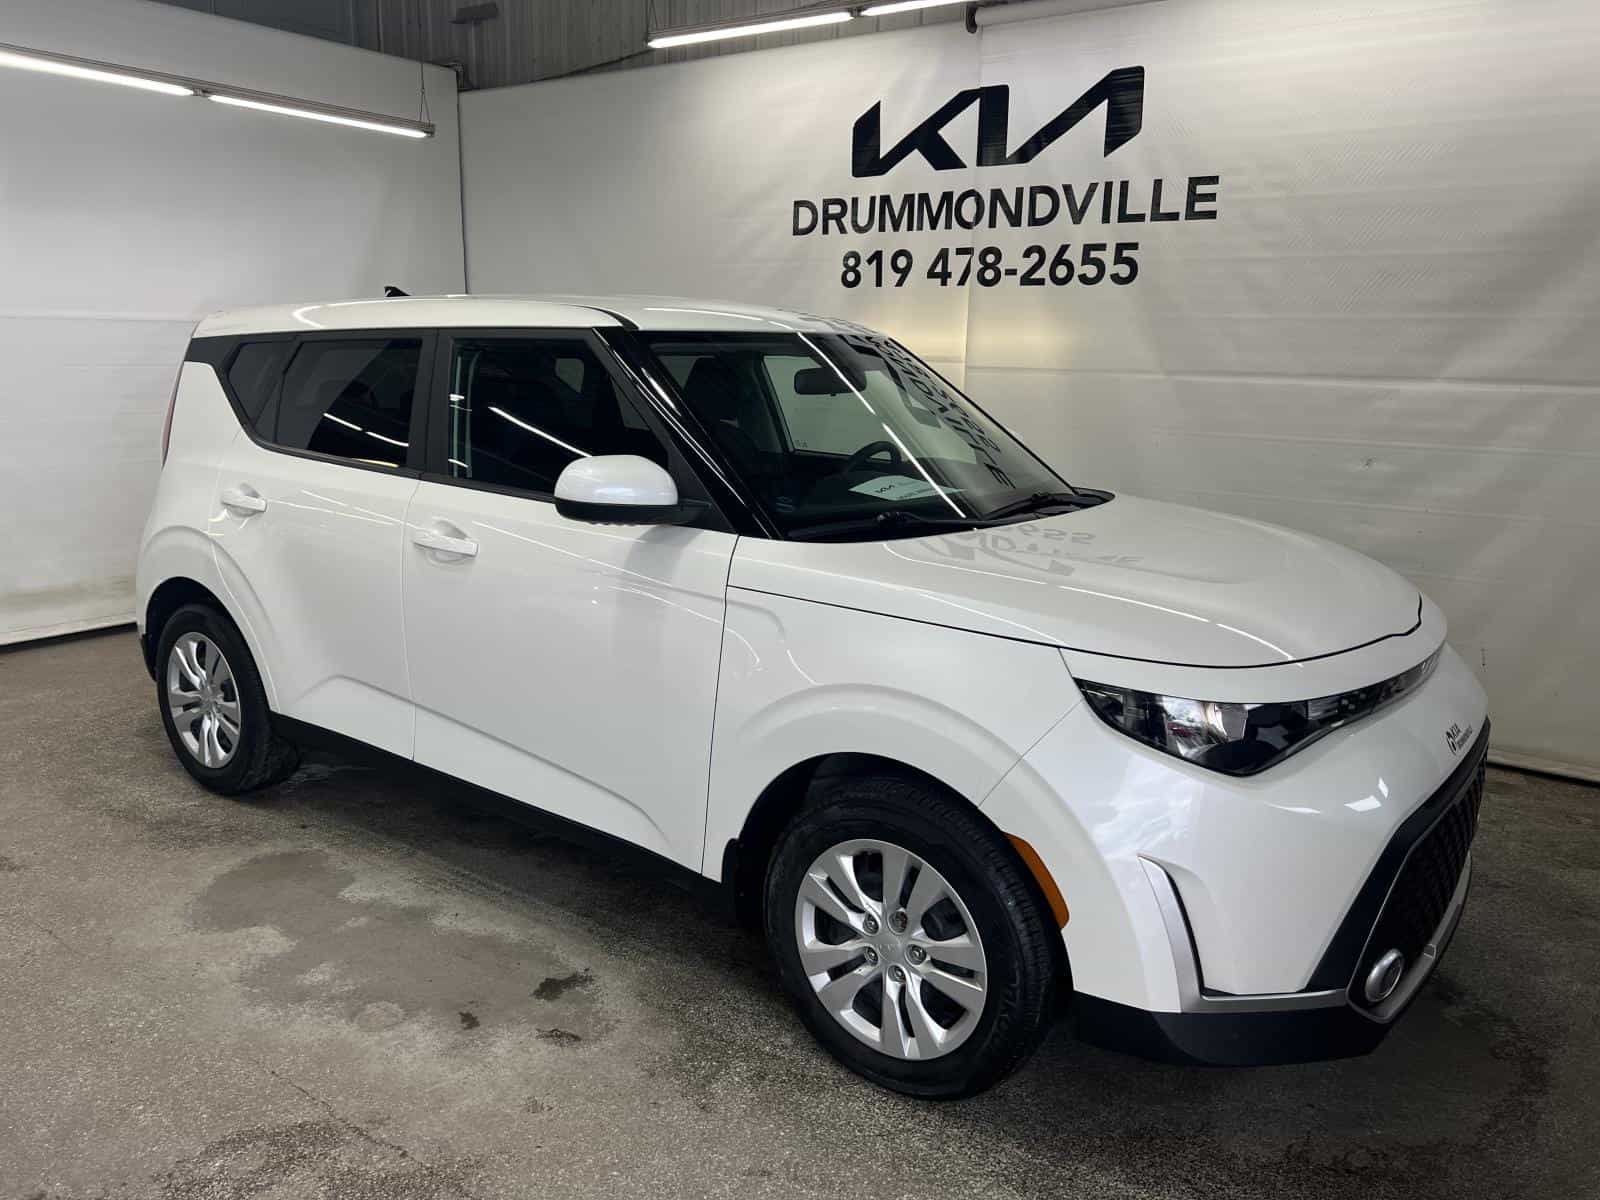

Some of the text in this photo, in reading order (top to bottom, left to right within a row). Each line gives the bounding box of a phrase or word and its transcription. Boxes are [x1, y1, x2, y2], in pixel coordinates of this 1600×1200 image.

[851, 65, 1145, 178] KIA
[792, 175, 1220, 236] DRUMMONDVILLE
[840, 241, 1140, 288] 819 478-2655
